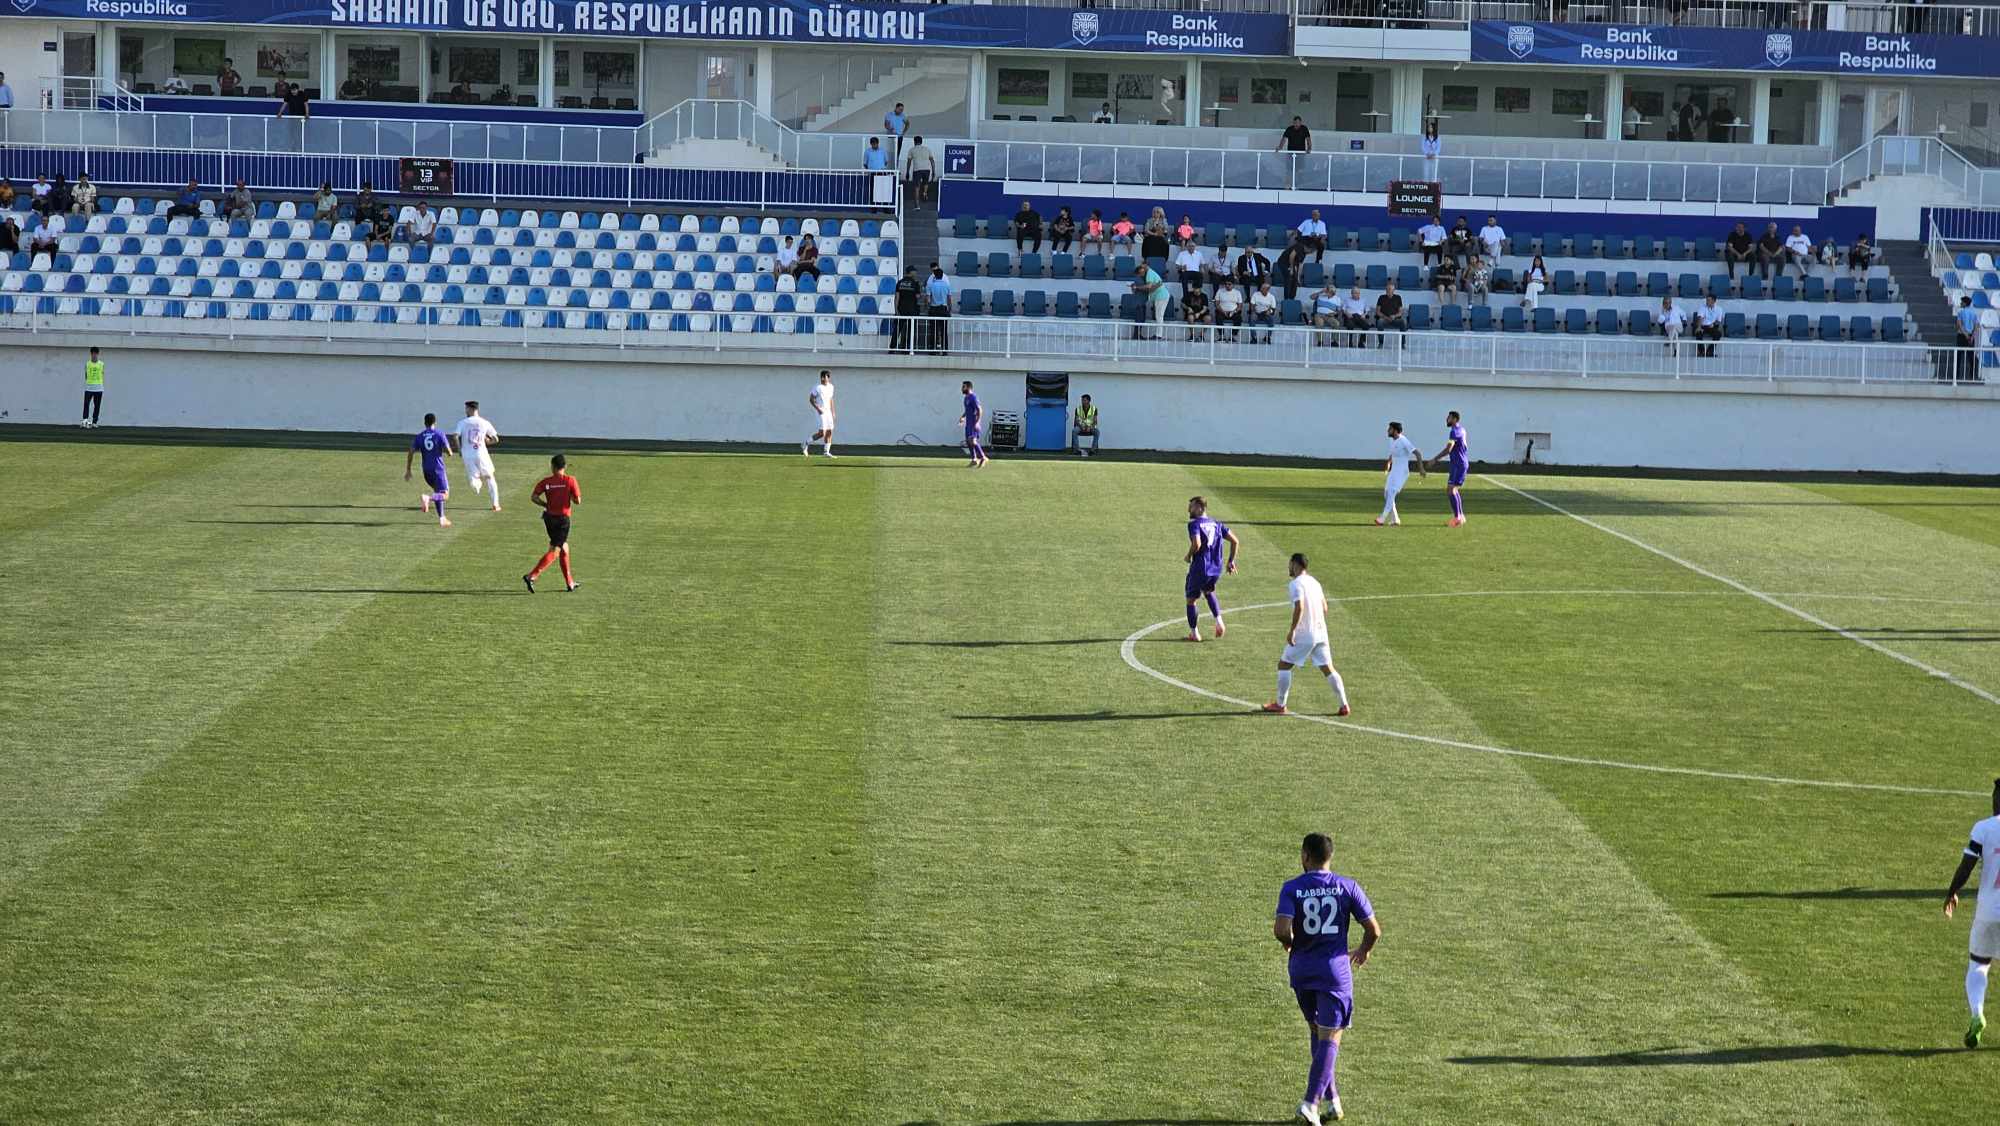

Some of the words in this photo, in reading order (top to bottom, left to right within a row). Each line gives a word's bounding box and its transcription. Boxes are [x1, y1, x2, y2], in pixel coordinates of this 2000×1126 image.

[86, 0, 187, 17] Respublika
[808, 4, 925, 40] QÜRURU!
[1172, 15, 1218, 31] Bank
[1146, 31, 1244, 50] Respublika
[1606, 28, 1652, 44] Bank
[1865, 36, 1911, 52] Bank
[1581, 44, 1678, 63] Respublika
[1839, 52, 1936, 71] Respublika
[420, 169, 433, 178] 13
[1395, 194, 1434, 203] LOUNGE
[424, 434, 434, 451] 6
[1296, 887, 1344, 898] R.ABBASOV
[1303, 895, 1339, 935] 82
